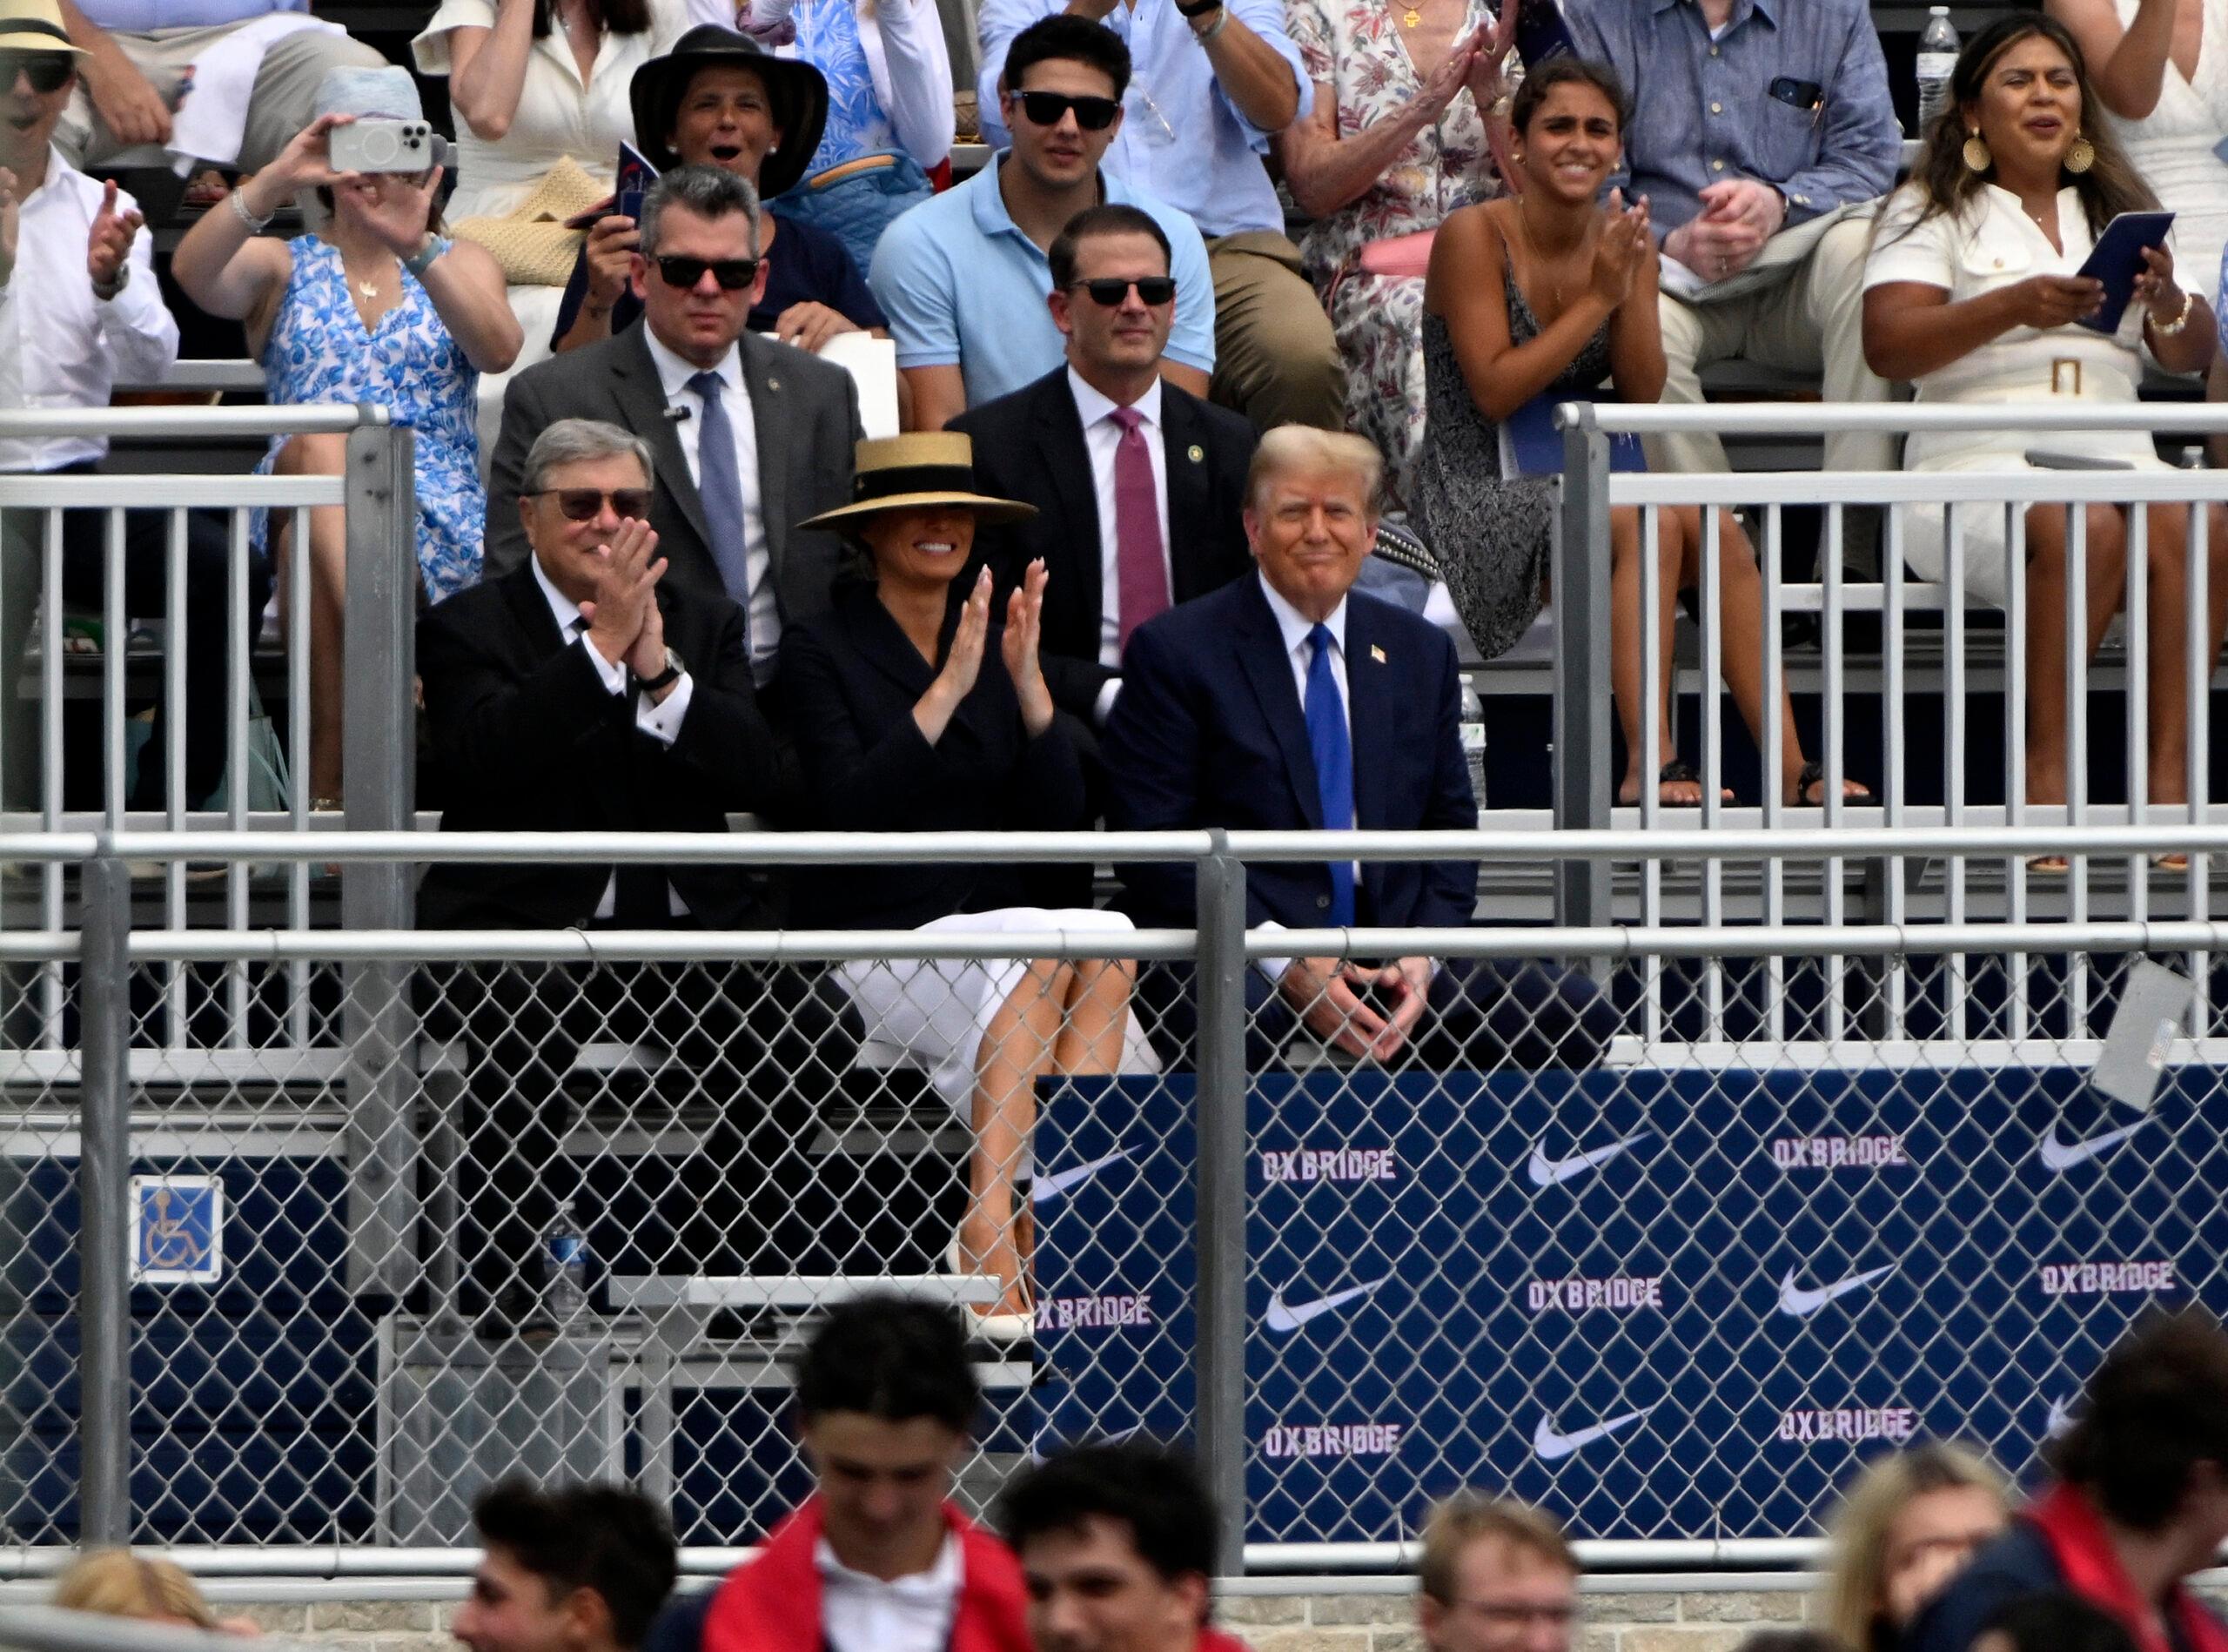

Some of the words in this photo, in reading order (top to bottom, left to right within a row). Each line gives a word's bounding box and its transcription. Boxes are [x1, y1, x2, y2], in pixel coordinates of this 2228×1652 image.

[1264, 1149, 1396, 1180] OXBRIDGE
[1775, 1136, 1907, 1167] OXBRIDGE
[2043, 1261, 2175, 1293] OXBRIDGE
[1529, 1278, 1663, 1310] OXBRIDGE
[1036, 1295, 1151, 1329] XBRIDGE
[1780, 1407, 1913, 1440] OXBRIDGE
[1265, 1424, 1400, 1456] OXBRIDGE
